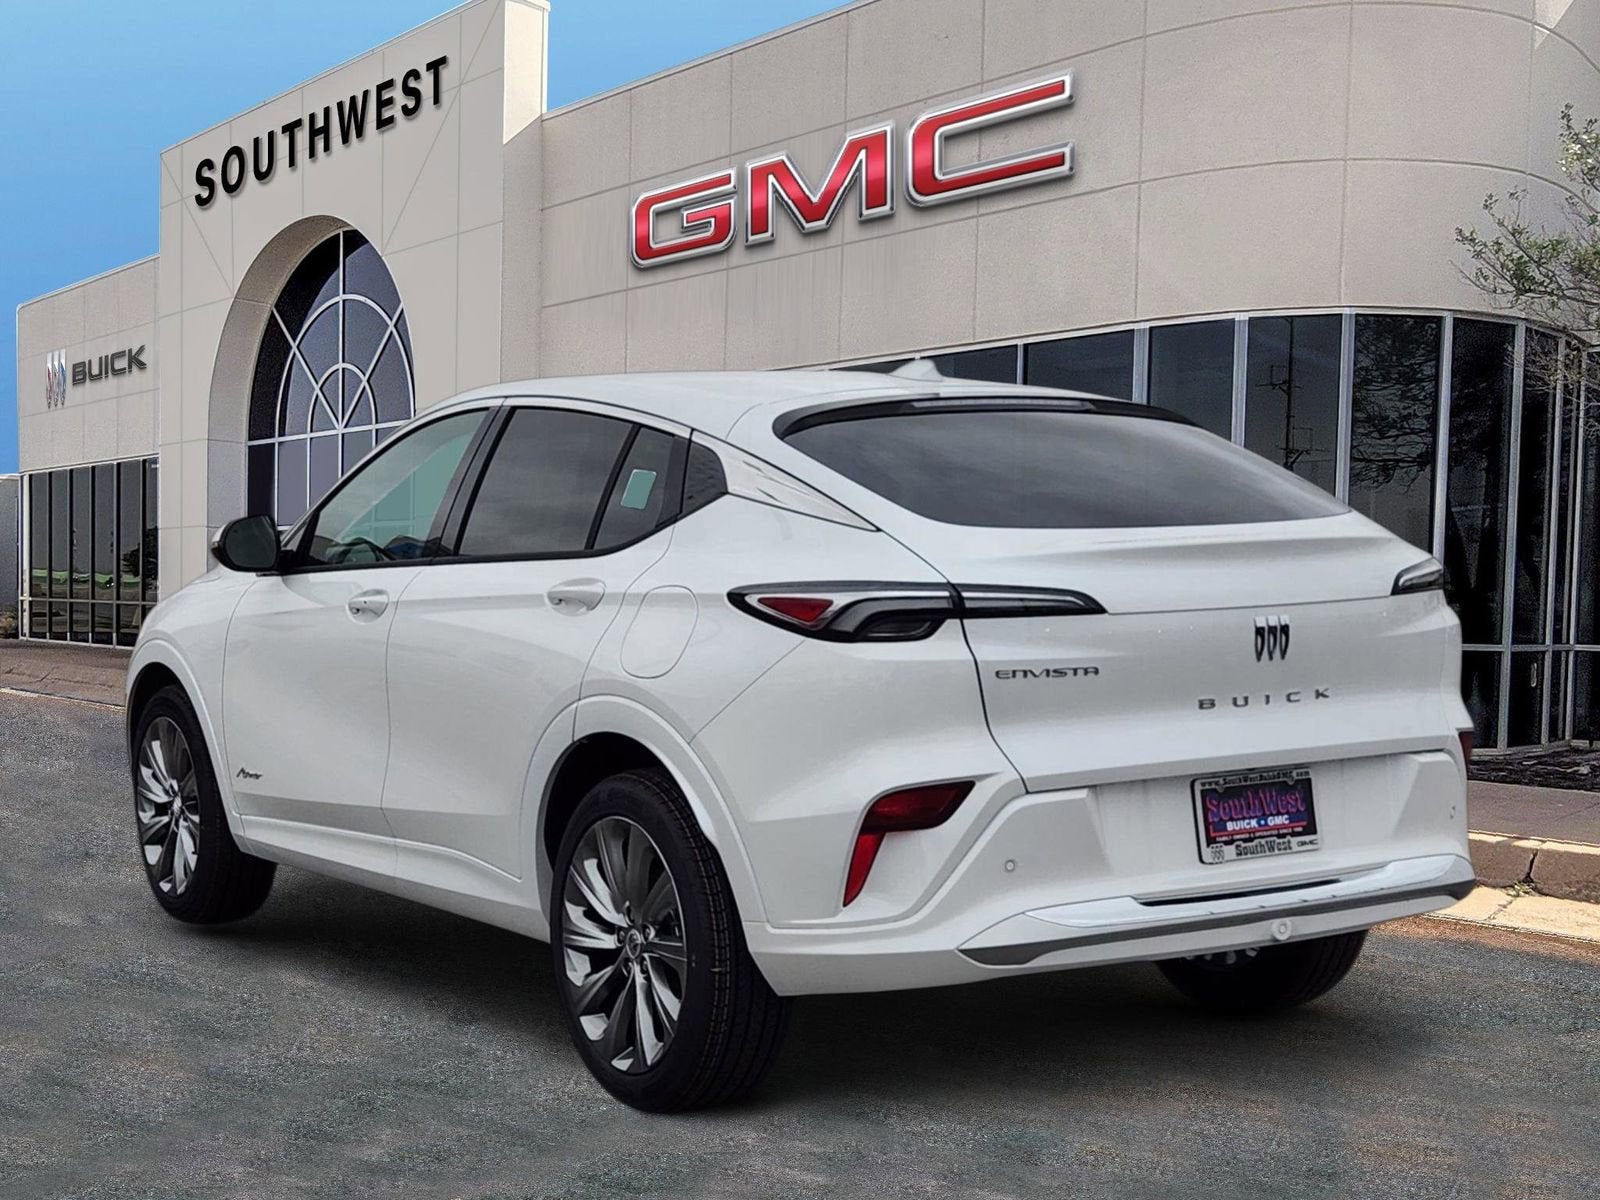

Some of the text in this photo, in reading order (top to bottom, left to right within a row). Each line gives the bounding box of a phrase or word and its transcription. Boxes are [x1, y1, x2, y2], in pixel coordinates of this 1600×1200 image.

[194, 55, 448, 207] SOUTHWEST
[630, 69, 1076, 269] GMC
[72, 344, 147, 386] BUICK
[995, 666, 1100, 680] ENVISTA
[1198, 687, 1331, 710] BUICK
[1226, 814, 1290, 831] BUICK GMC
[1235, 838, 1293, 857] SouthWest
[1297, 838, 1319, 848] GMC
